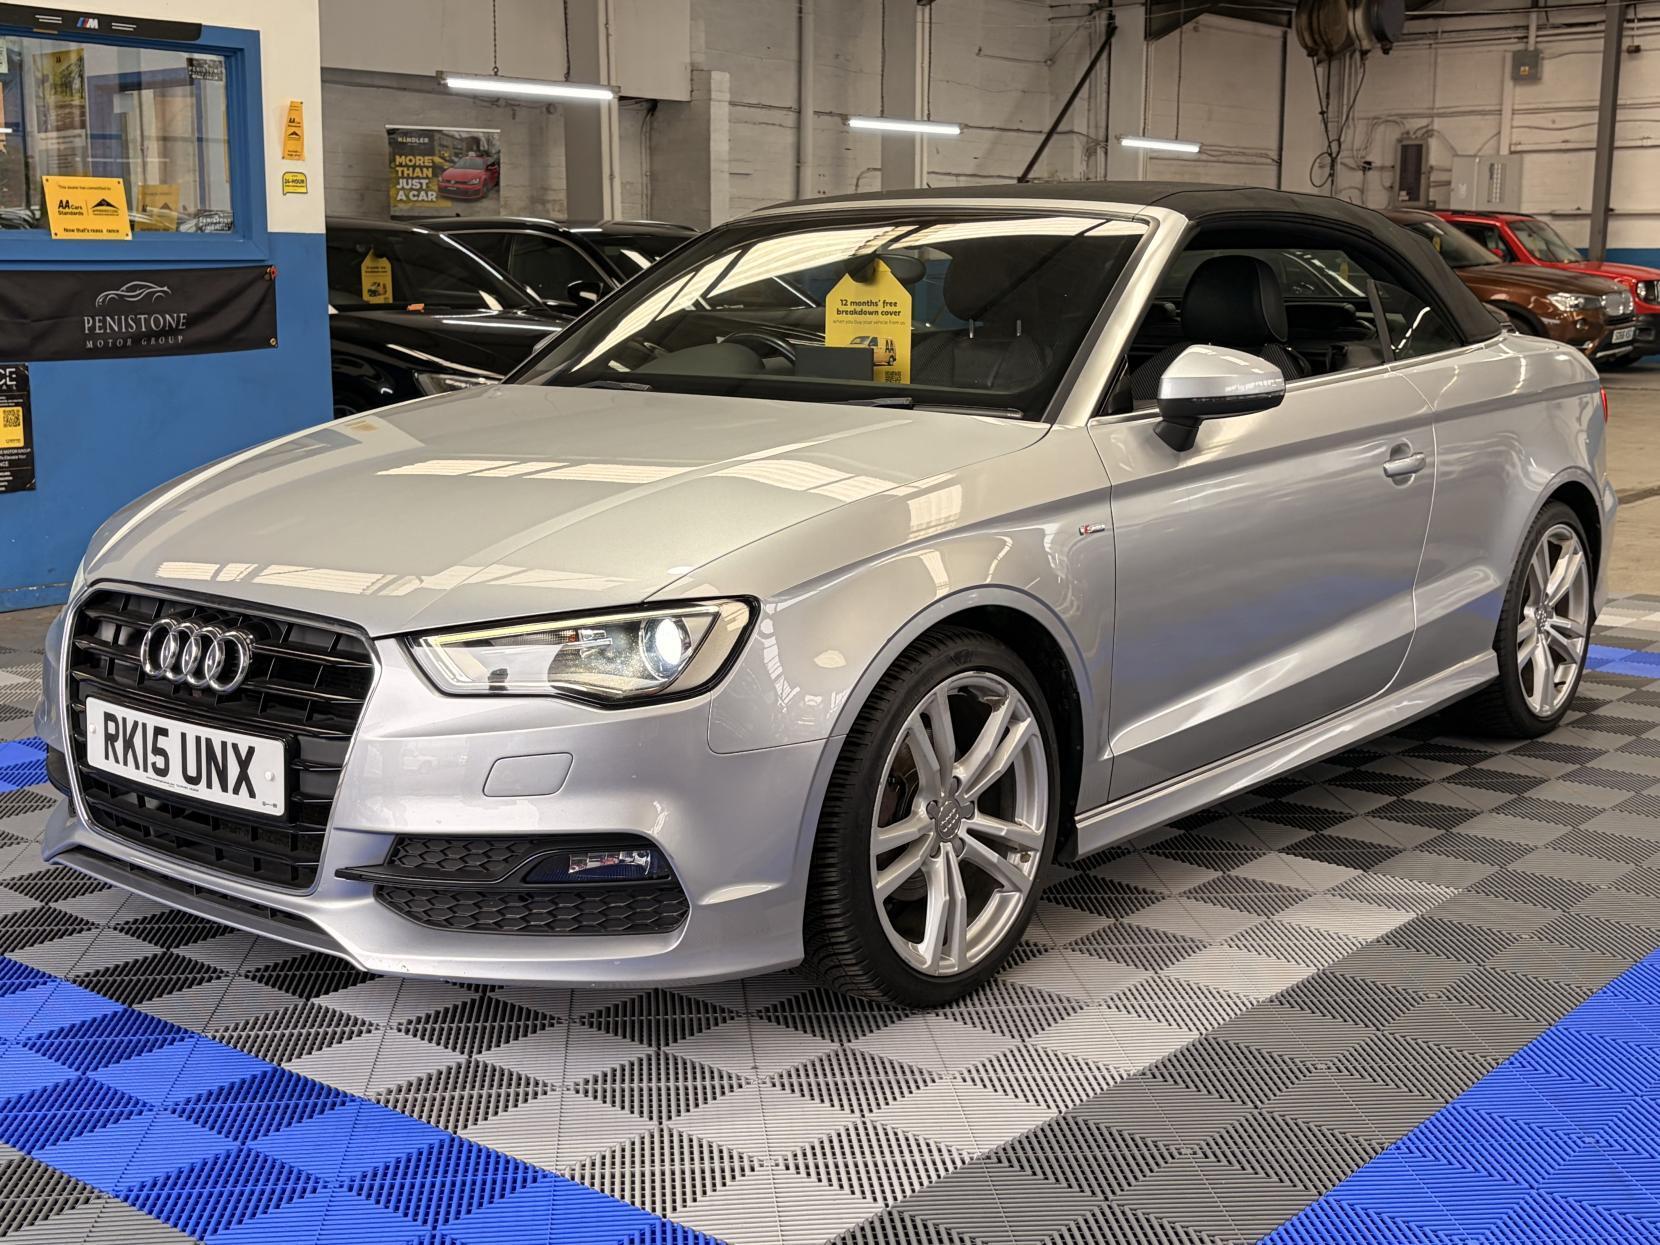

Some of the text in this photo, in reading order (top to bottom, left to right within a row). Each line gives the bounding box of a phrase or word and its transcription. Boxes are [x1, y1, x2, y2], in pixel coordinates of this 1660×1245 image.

[395, 155, 433, 166] MORE
[395, 167, 433, 178] THAN
[396, 178, 429, 190] JUST
[396, 190, 437, 202] A CAR
[58, 199, 70, 210] AA
[840, 298, 898, 308] 12 months' free
[836, 307, 901, 317] breakdown cover
[83, 313, 188, 334] PENISTONE
[85, 335, 183, 349] MOTOR GROUP
[884, 339, 894, 354] AA
[103, 711, 257, 800] RK15 UNX
